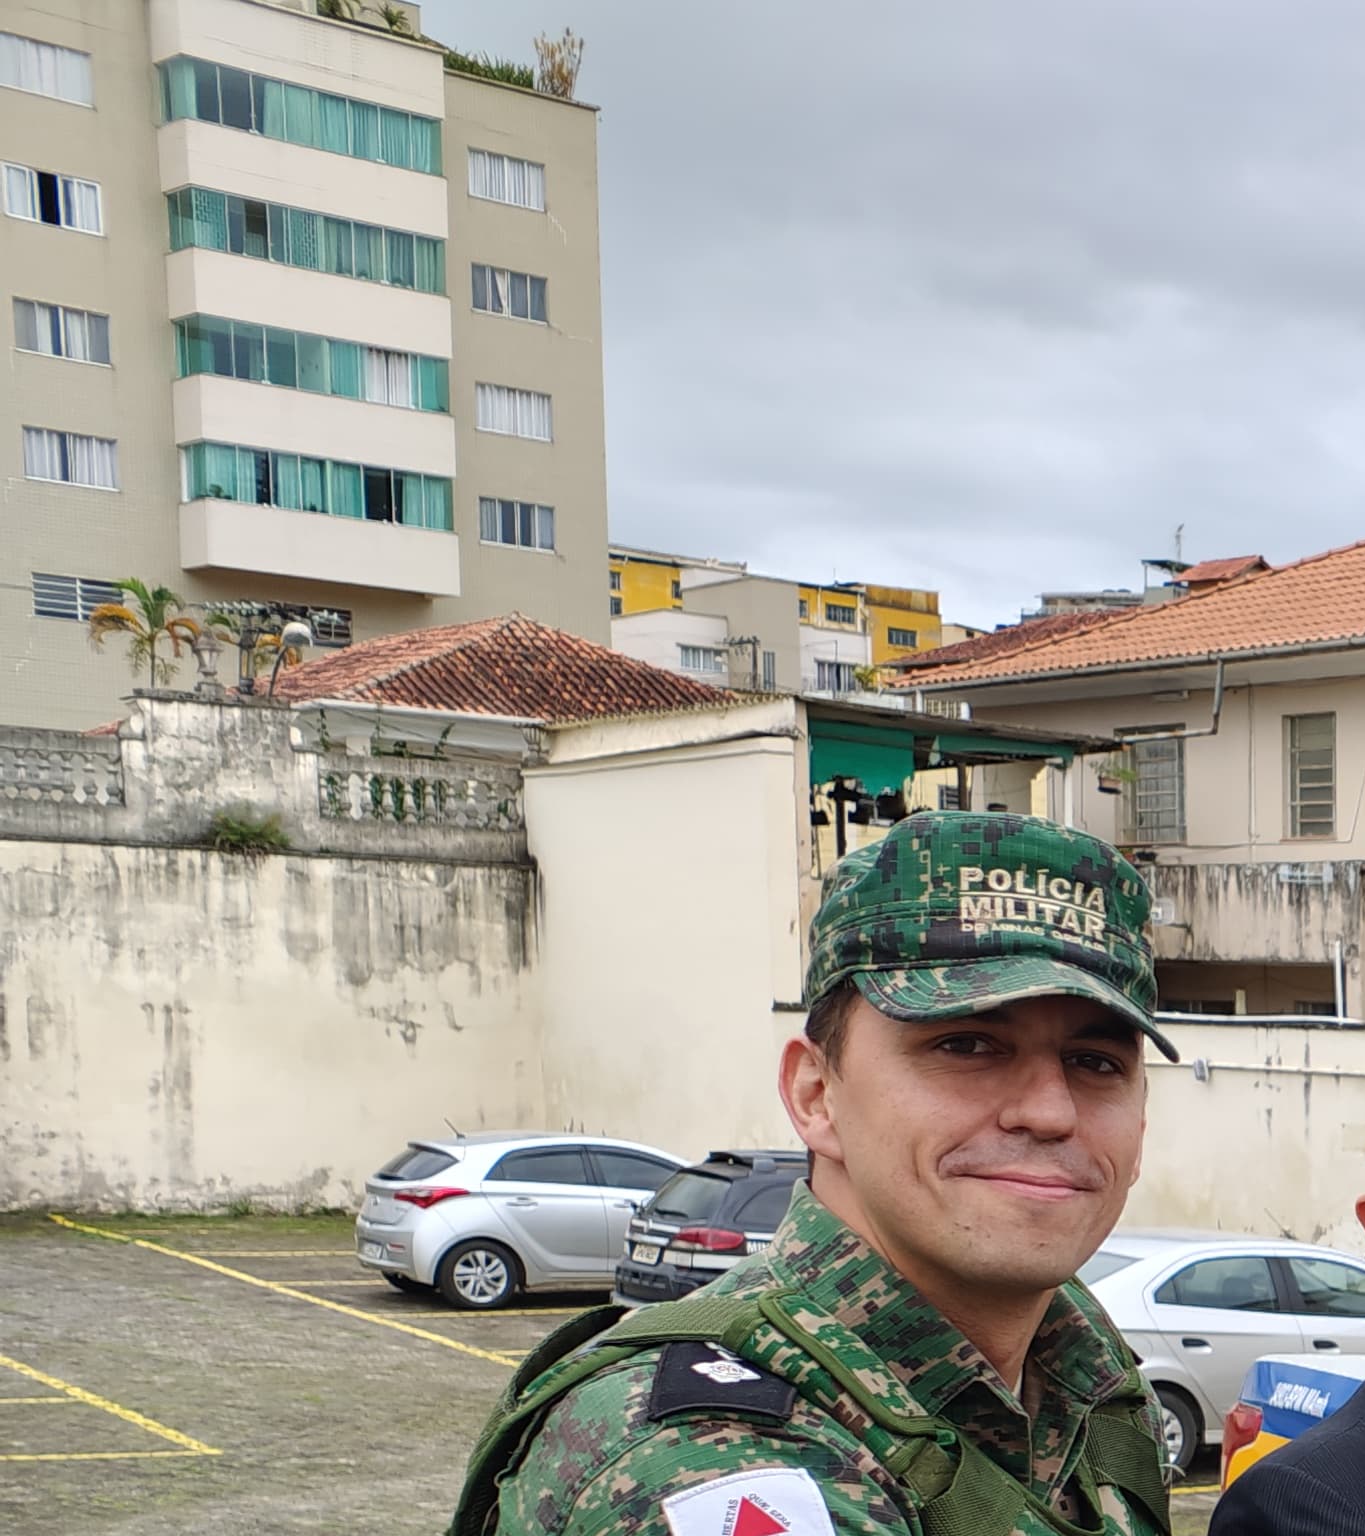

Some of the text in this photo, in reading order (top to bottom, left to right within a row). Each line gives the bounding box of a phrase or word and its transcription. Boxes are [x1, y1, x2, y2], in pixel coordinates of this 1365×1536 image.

[958, 866, 1107, 916] POLÍCIA
[959, 896, 1107, 943] MILITAR
[961, 923, 984, 933] DE
[991, 922, 1046, 936] MINAS
